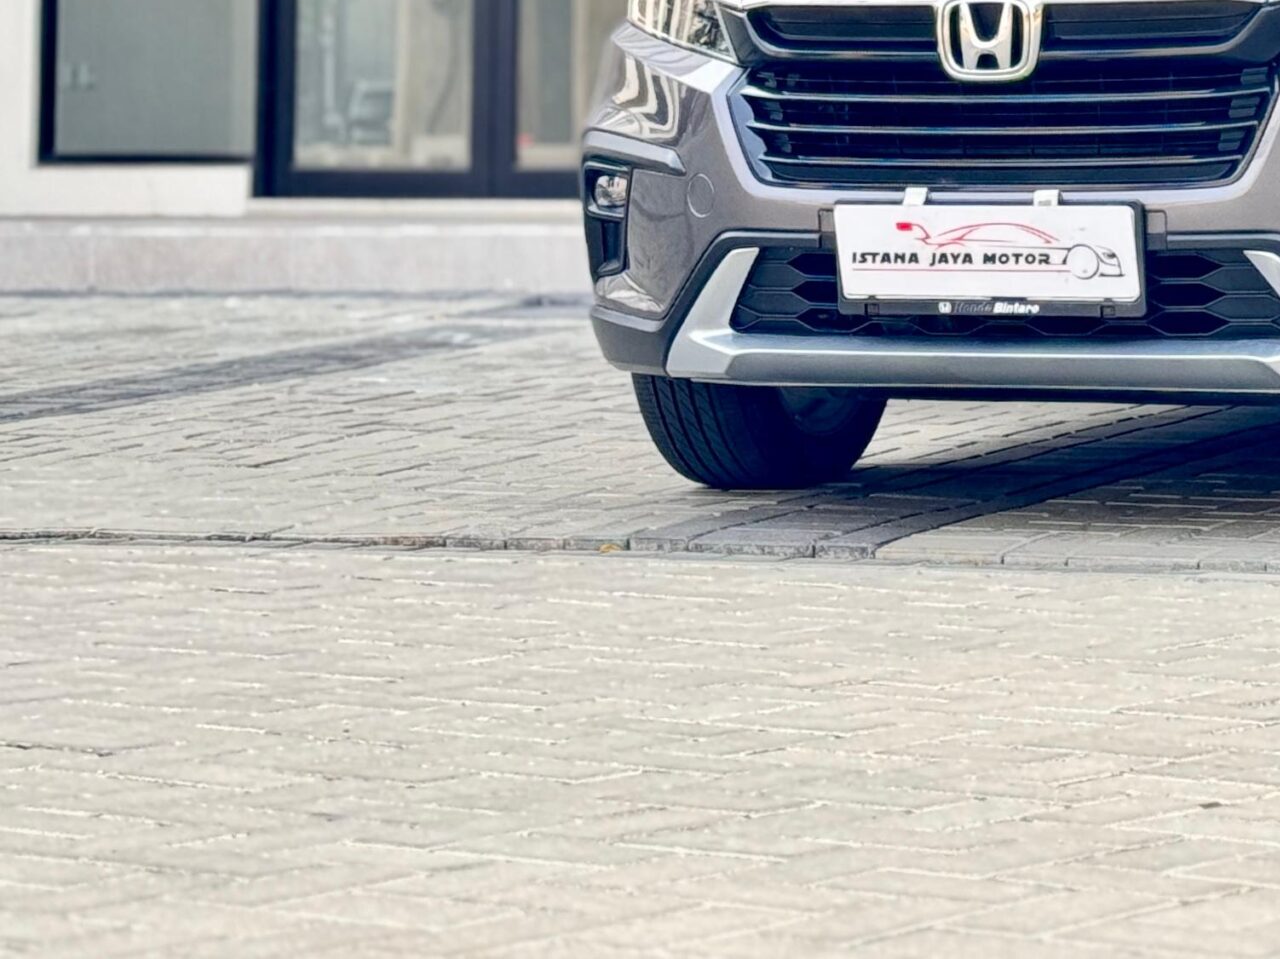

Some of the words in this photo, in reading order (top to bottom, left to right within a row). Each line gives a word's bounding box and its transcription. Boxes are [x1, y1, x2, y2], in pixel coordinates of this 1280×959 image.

[852, 250, 920, 265] ISTANA
[929, 251, 973, 266] JAYA
[983, 252, 1052, 265] MOTOR
[992, 301, 1040, 314] Bintaro
